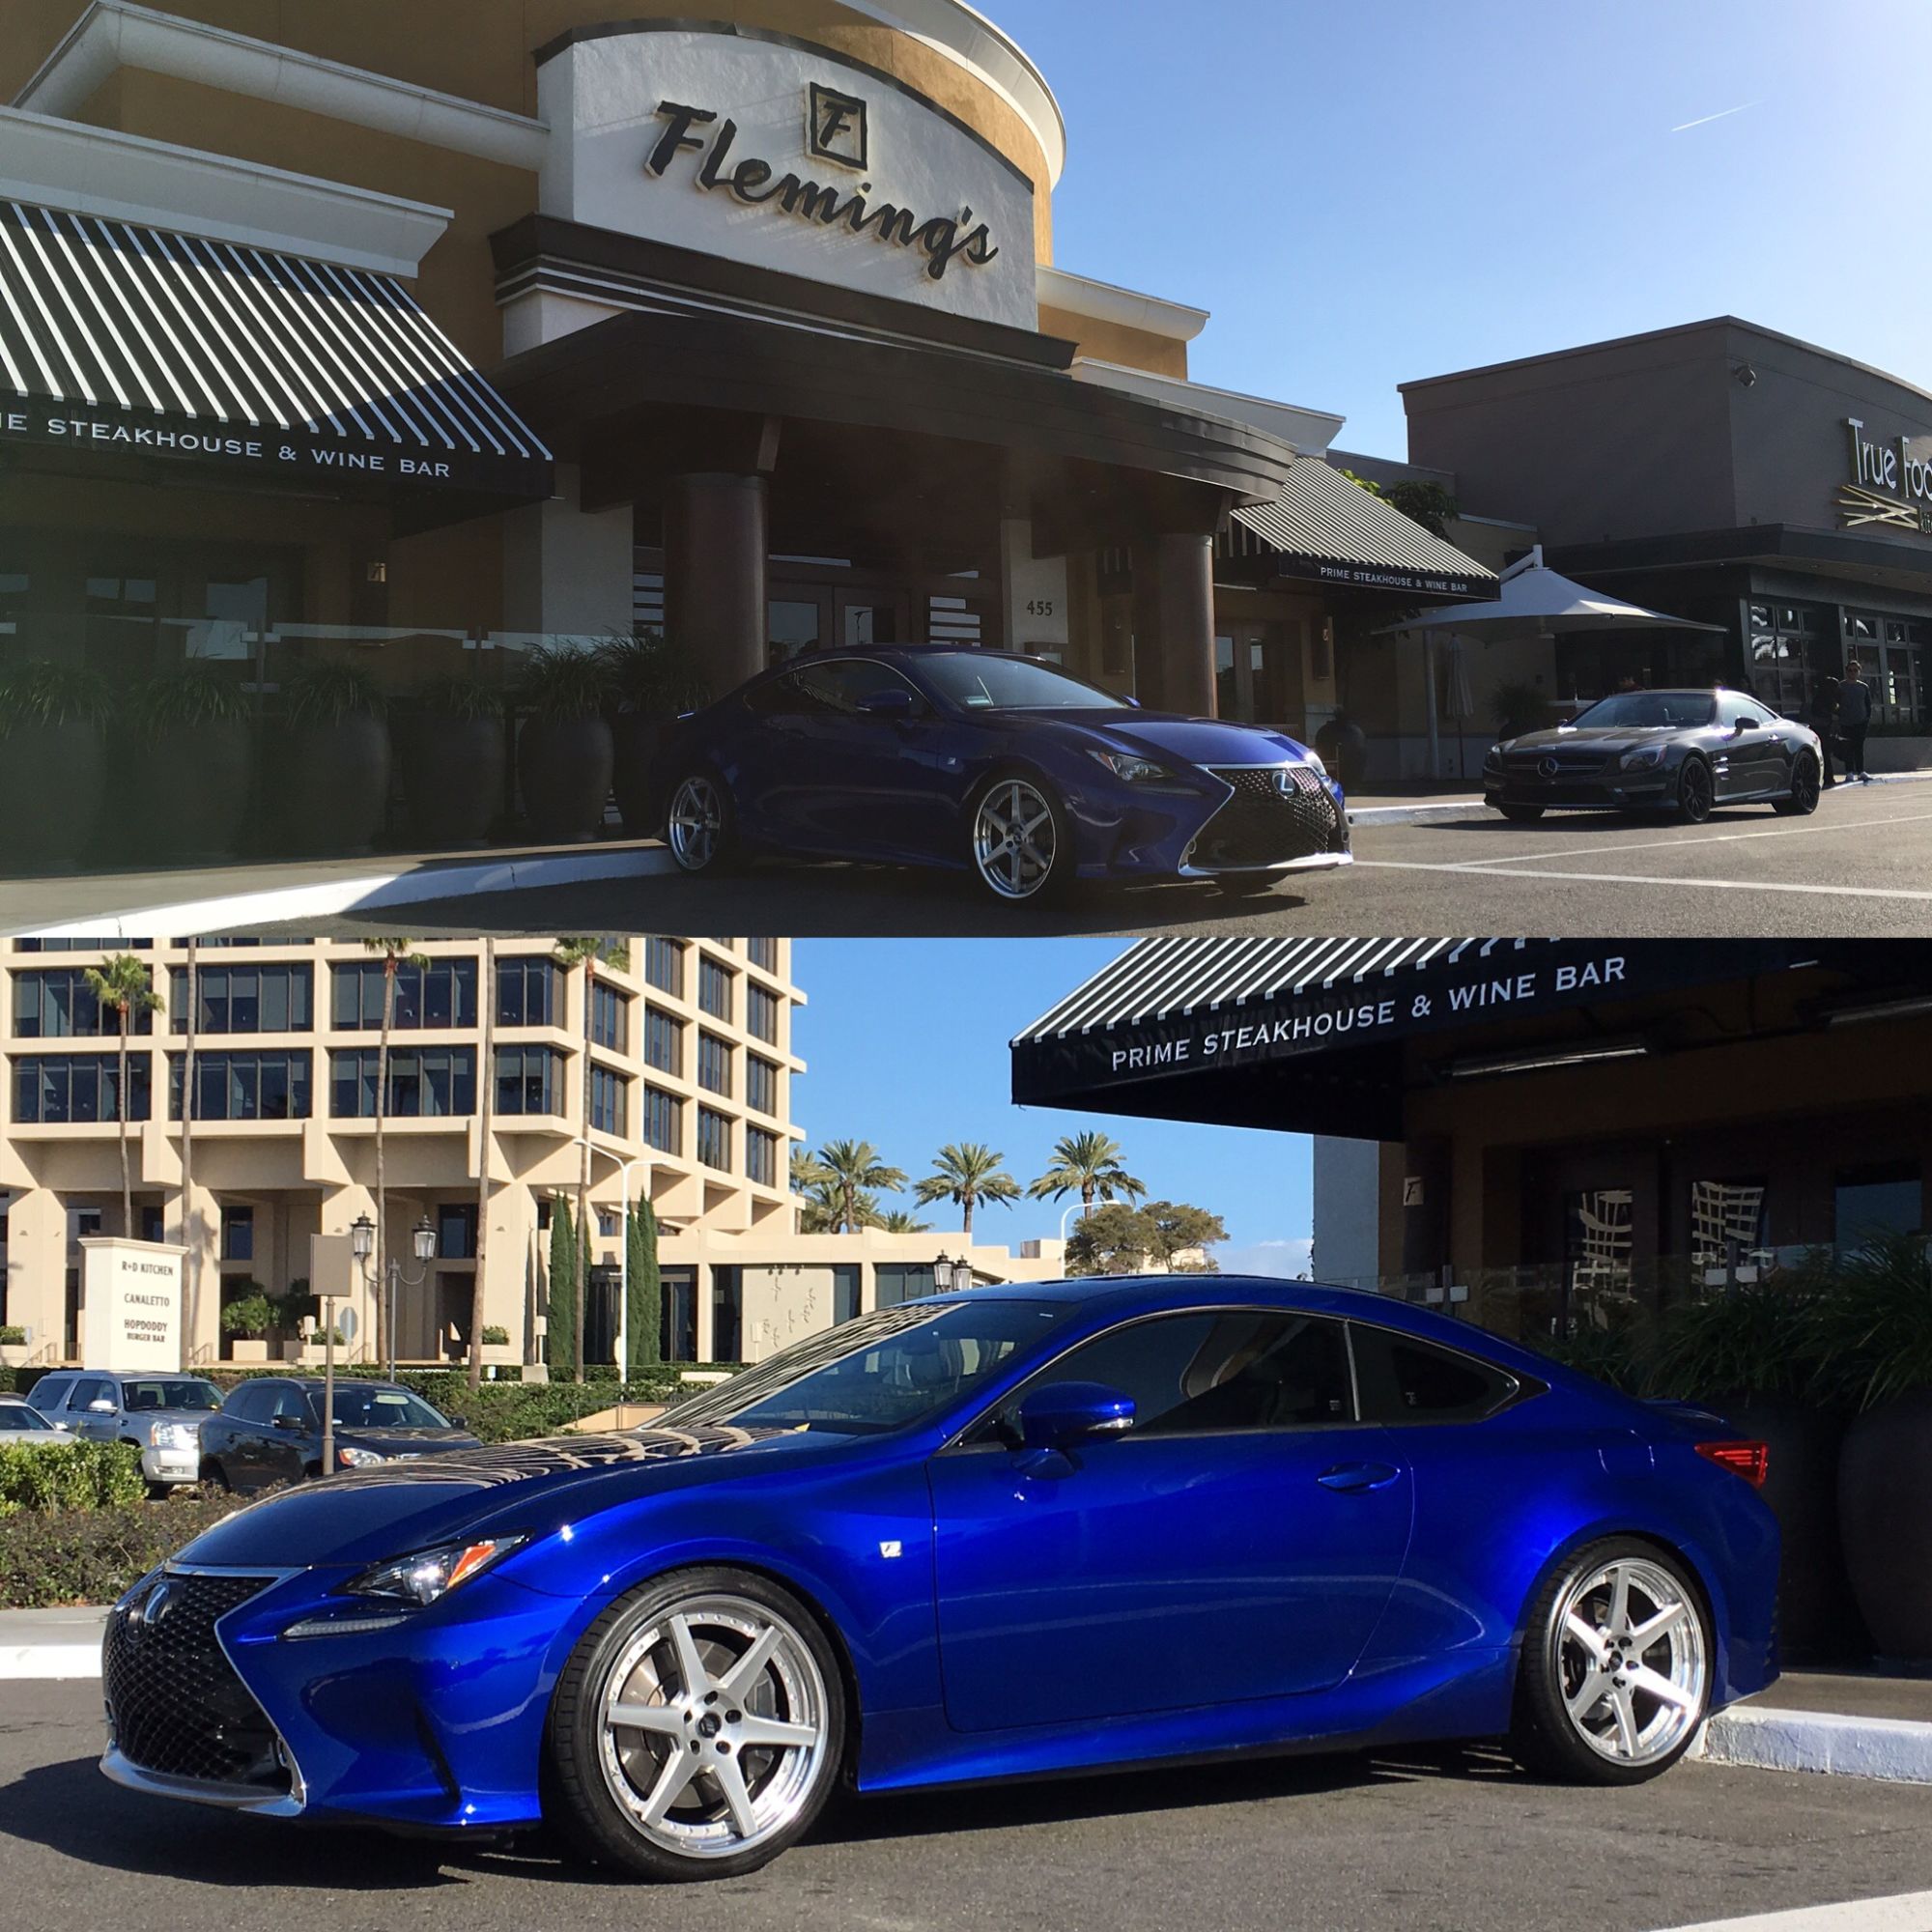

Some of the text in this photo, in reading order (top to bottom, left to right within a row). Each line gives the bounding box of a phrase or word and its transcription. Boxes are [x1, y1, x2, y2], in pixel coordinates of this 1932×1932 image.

[646, 99, 999, 280] Fleming's
[0, 412, 450, 478] E STEAKHOUSE & WINE BAR
[1848, 417, 1897, 490] True
[1321, 567, 1468, 592] PRIME STEAKHOUSE & WINE BAR
[1027, 600, 1053, 616] 455
[1112, 955, 1626, 1071] PRIME STEAKHOUSE & WINE BAR
[122, 1261, 174, 1276] R+D KITCHEN
[124, 1293, 170, 1307] CANALETTO
[124, 1319, 168, 1332] HOPDODDY
[127, 1332, 165, 1343] BURGER BAR
